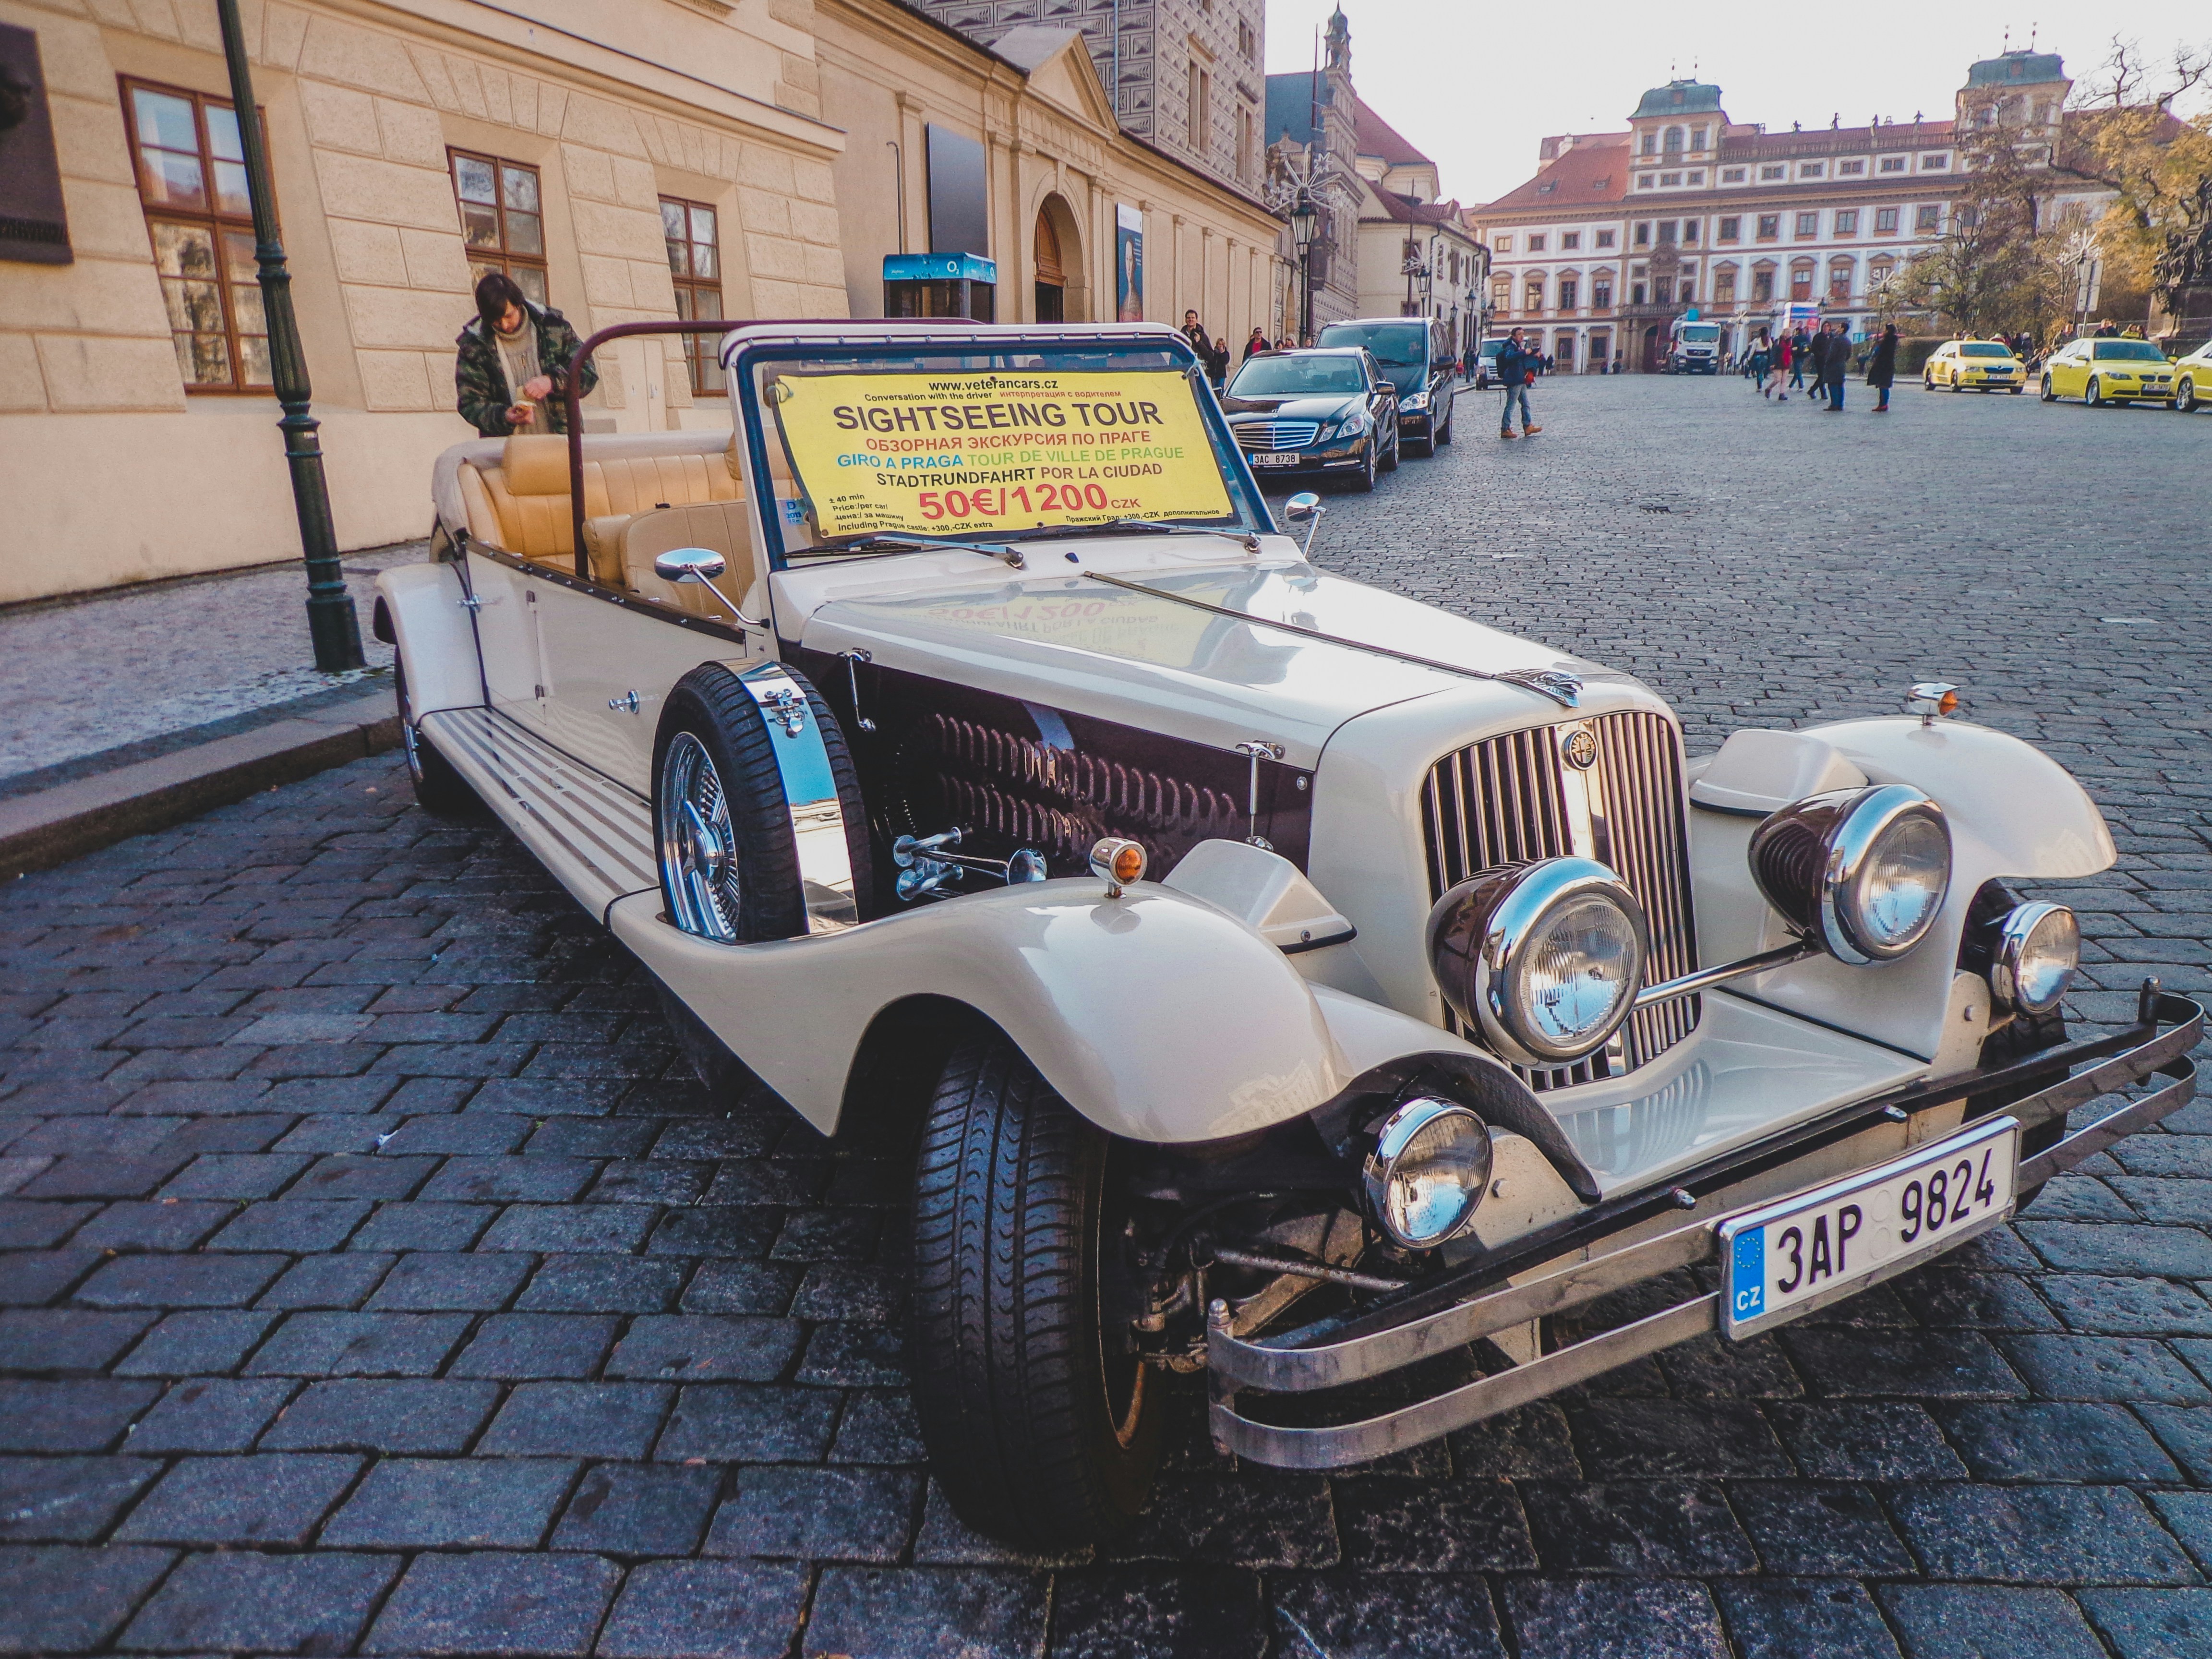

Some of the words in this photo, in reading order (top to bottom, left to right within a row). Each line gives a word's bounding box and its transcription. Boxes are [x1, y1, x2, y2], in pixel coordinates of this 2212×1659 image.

[929, 380, 1058, 391] www.veterancars.cz
[865, 394, 926, 402] Conversation
[833, 403, 1067, 433] SIGHTSEEING
[1071, 401, 1164, 427] TOUR
[866, 437, 962, 452] ОБЗОРНАЯ
[967, 433, 1067, 449] ЭКСКУРСИЯ
[1072, 433, 1095, 445] ПО
[1100, 431, 1152, 445] ПРАГЕ
[837, 454, 881, 467] GIRO
[886, 457, 897, 469] A
[901, 455, 964, 469] PRAGA
[967, 452, 1014, 466] TOUR
[1020, 450, 1043, 463] DE
[1046, 450, 1091, 462] VILLE
[1095, 449, 1116, 461] DE
[1121, 447, 1185, 460] PRAGUE
[1255, 456, 1269, 464] 3AC
[1275, 455, 1296, 463] 8738
[877, 468, 1035, 487] STADTRUNDFAHRT
[1041, 467, 1074, 480] POR
[1078, 467, 1099, 479] LA
[1103, 463, 1163, 478] CIUDAD
[919, 483, 1108, 520] 50€/1200
[1110, 498, 1142, 509] CZK
[875, 513, 903, 521] машину
[1065, 515, 1101, 523] Пражский
[1164, 509, 1220, 517] дополнительное
[838, 521, 878, 531] Including
[879, 521, 905, 529] Prague
[1778, 1204, 1863, 1294] 3AP
[1900, 1148, 1995, 1243] 9824
[1736, 1286, 1761, 1311] CZ
